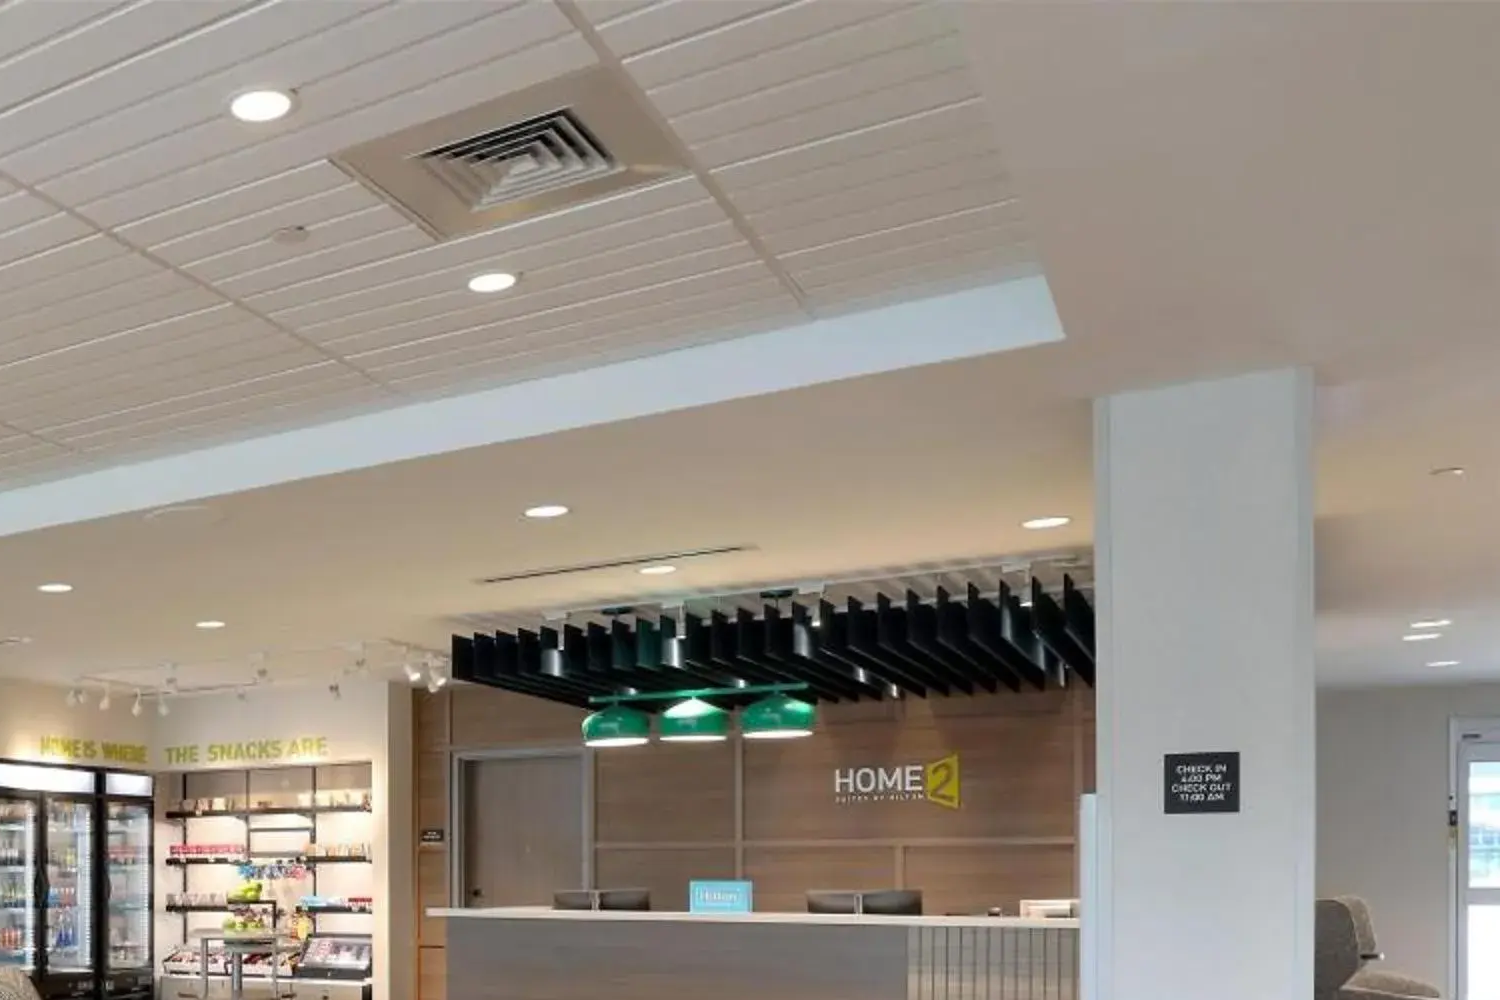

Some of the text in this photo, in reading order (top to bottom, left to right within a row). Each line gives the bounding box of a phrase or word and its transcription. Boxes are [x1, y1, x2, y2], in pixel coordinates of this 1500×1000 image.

[164, 736, 328, 764] THE SNACKS ARE
[1176, 763, 1227, 774] CHECK IN
[835, 765, 924, 793] HOME
[1205, 773, 1222, 782] PM
[1172, 783, 1232, 793] CHECK OUT
[1207, 793, 1225, 801] AM
